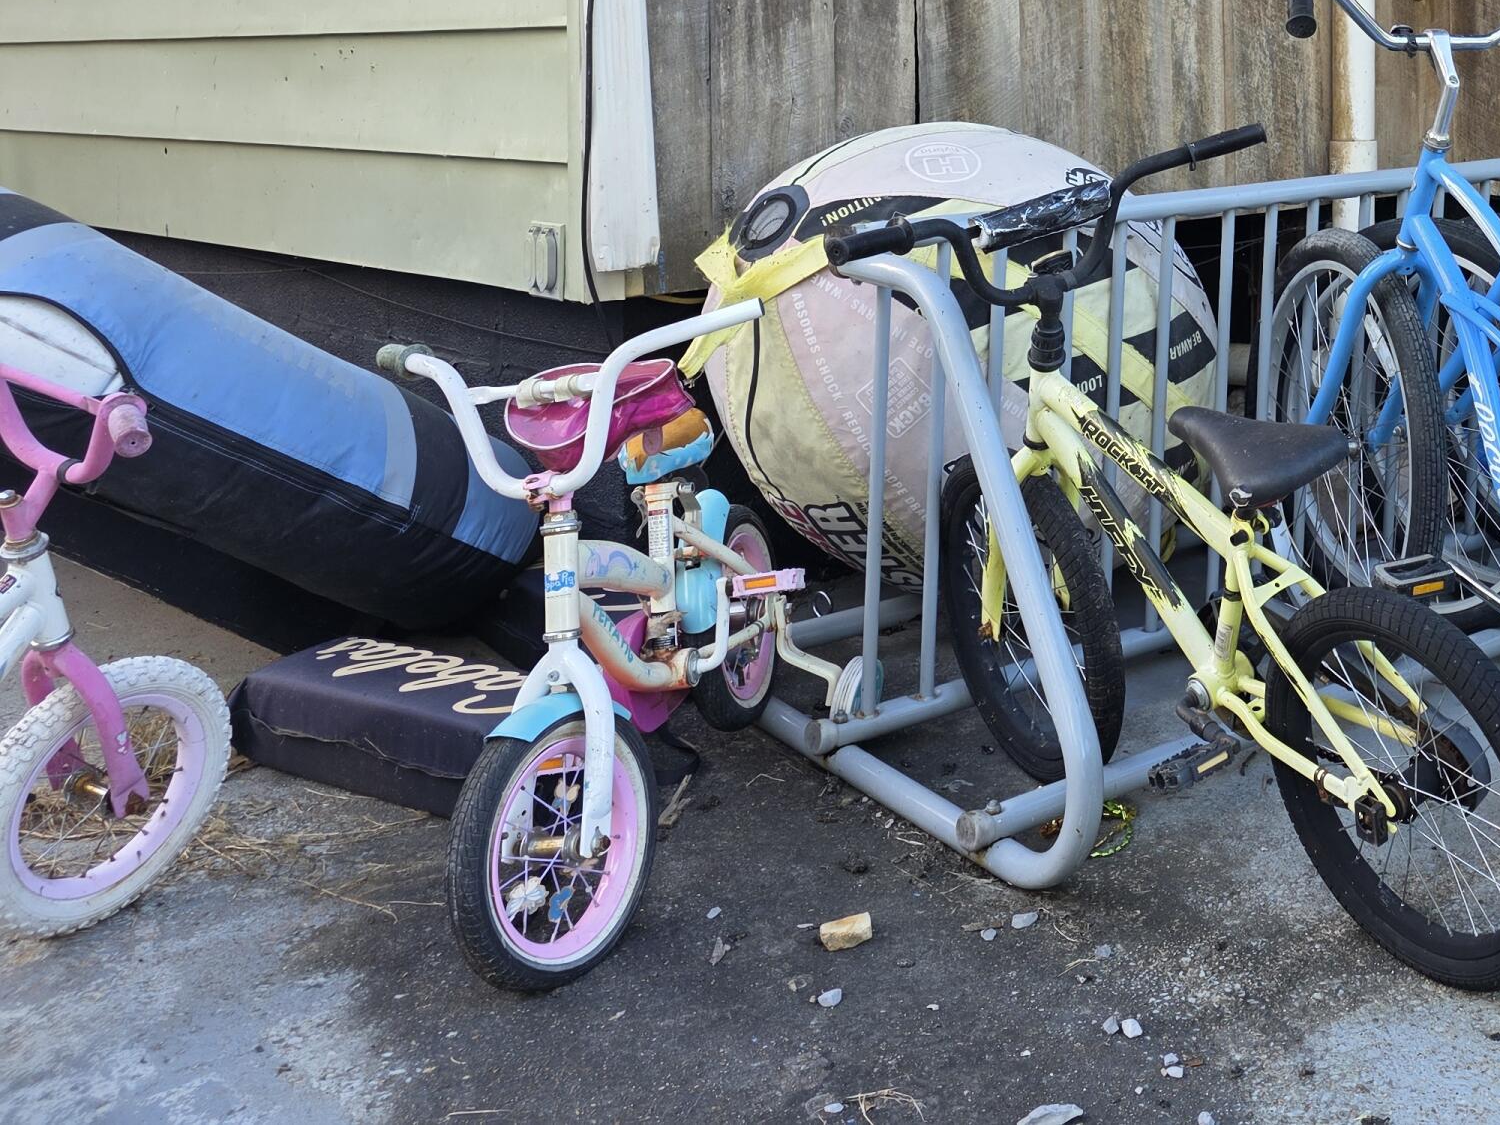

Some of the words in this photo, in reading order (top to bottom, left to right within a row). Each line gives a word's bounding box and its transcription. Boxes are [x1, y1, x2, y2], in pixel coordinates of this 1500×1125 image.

[791, 292, 821, 354] ABSORBS
[816, 357, 844, 402] SHOCK
[315, 637, 529, 714] Cabela's
